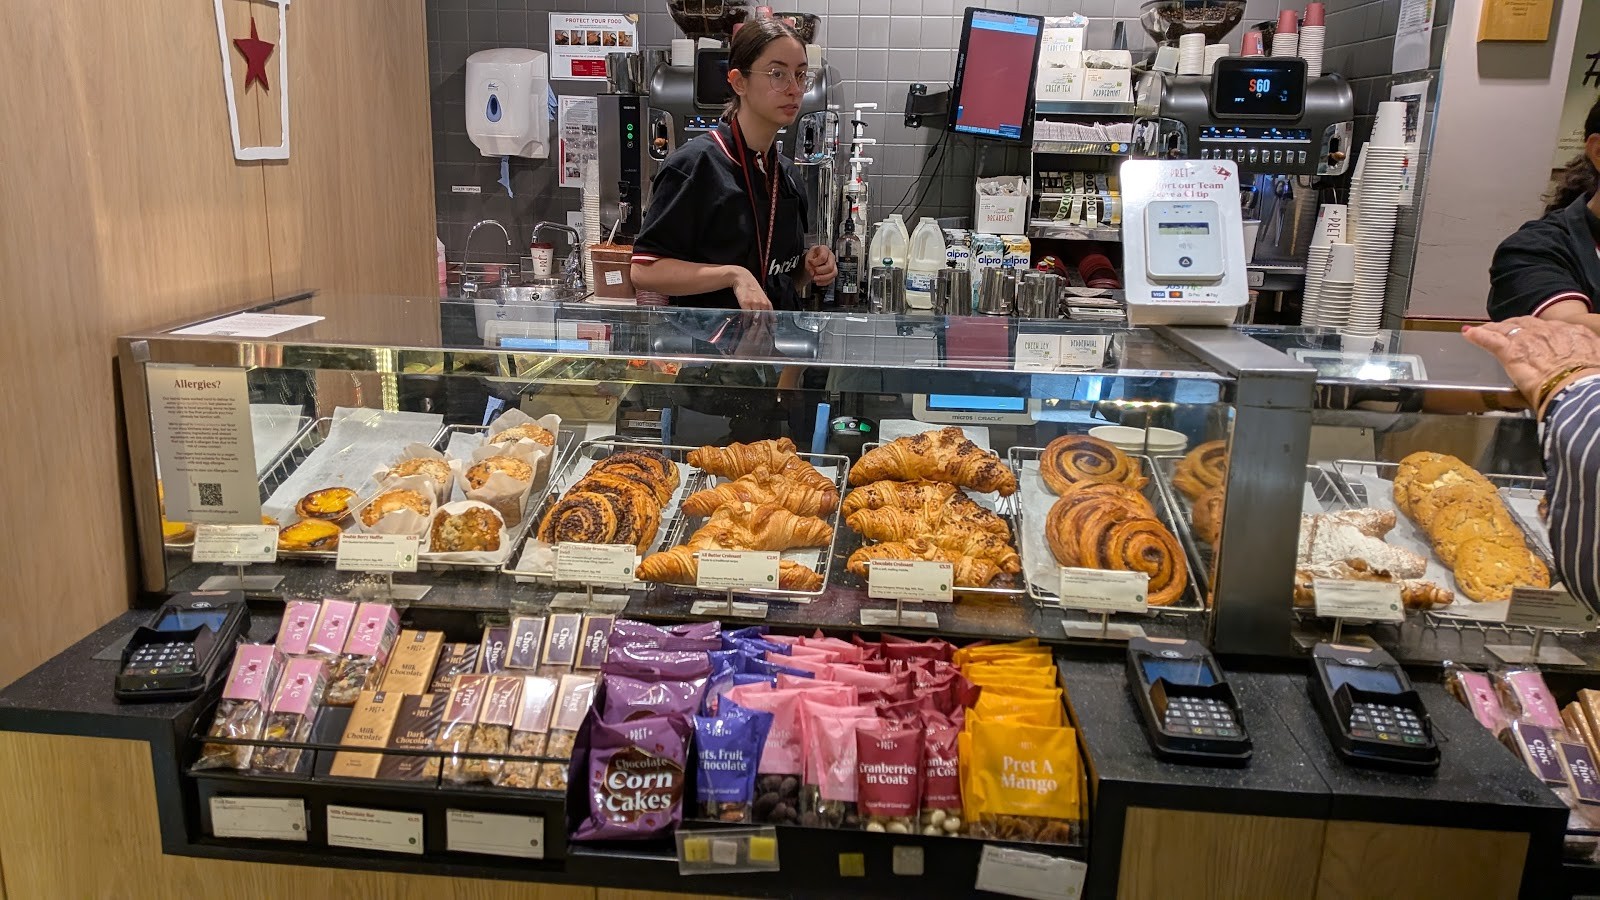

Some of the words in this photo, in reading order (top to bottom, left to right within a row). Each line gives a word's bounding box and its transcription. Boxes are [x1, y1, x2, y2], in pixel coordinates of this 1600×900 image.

[1045, 84, 1061, 92] GREEN
[1062, 85, 1071, 93] TEA
[1093, 89, 1121, 97] PEPPERMINT
[1170, 168, 1188, 178] PRET
[1196, 191, 1209, 199] tip
[987, 214, 1013, 222] BREAKFAST
[1326, 217, 1342, 239] PRET
[946, 250, 969, 260] alpro
[978, 255, 1001, 266] alpro
[174, 379, 221, 391] Allergies?
[520, 631, 534, 654] Choc
[558, 627, 570, 650] Choc
[591, 630, 603, 654] Choc
[491, 641, 504, 664] Choc
[390, 669, 423, 677] Chocolate
[461, 688, 475, 707] Pret
[497, 690, 510, 708] Pret
[568, 692, 582, 712] Pret
[346, 732, 383, 742] Chocolate
[359, 727, 374, 735] Milk
[406, 731, 425, 739] Dark
[630, 728, 647, 740] PRET
[396, 736, 433, 746] Chocolate
[718, 749, 743, 761] Fruit
[1532, 738, 1551, 766] Choc
[615, 757, 668, 770] Chocolate
[860, 762, 917, 776] Cranberries
[1003, 756, 1036, 774] Pret
[1042, 759, 1054, 775] A
[1575, 758, 1592, 785] Choc
[608, 770, 673, 790] Corn
[867, 774, 877, 784] in
[878, 774, 909, 785] Coats
[1001, 773, 1058, 795] Mango
[606, 791, 672, 812] Cakes
